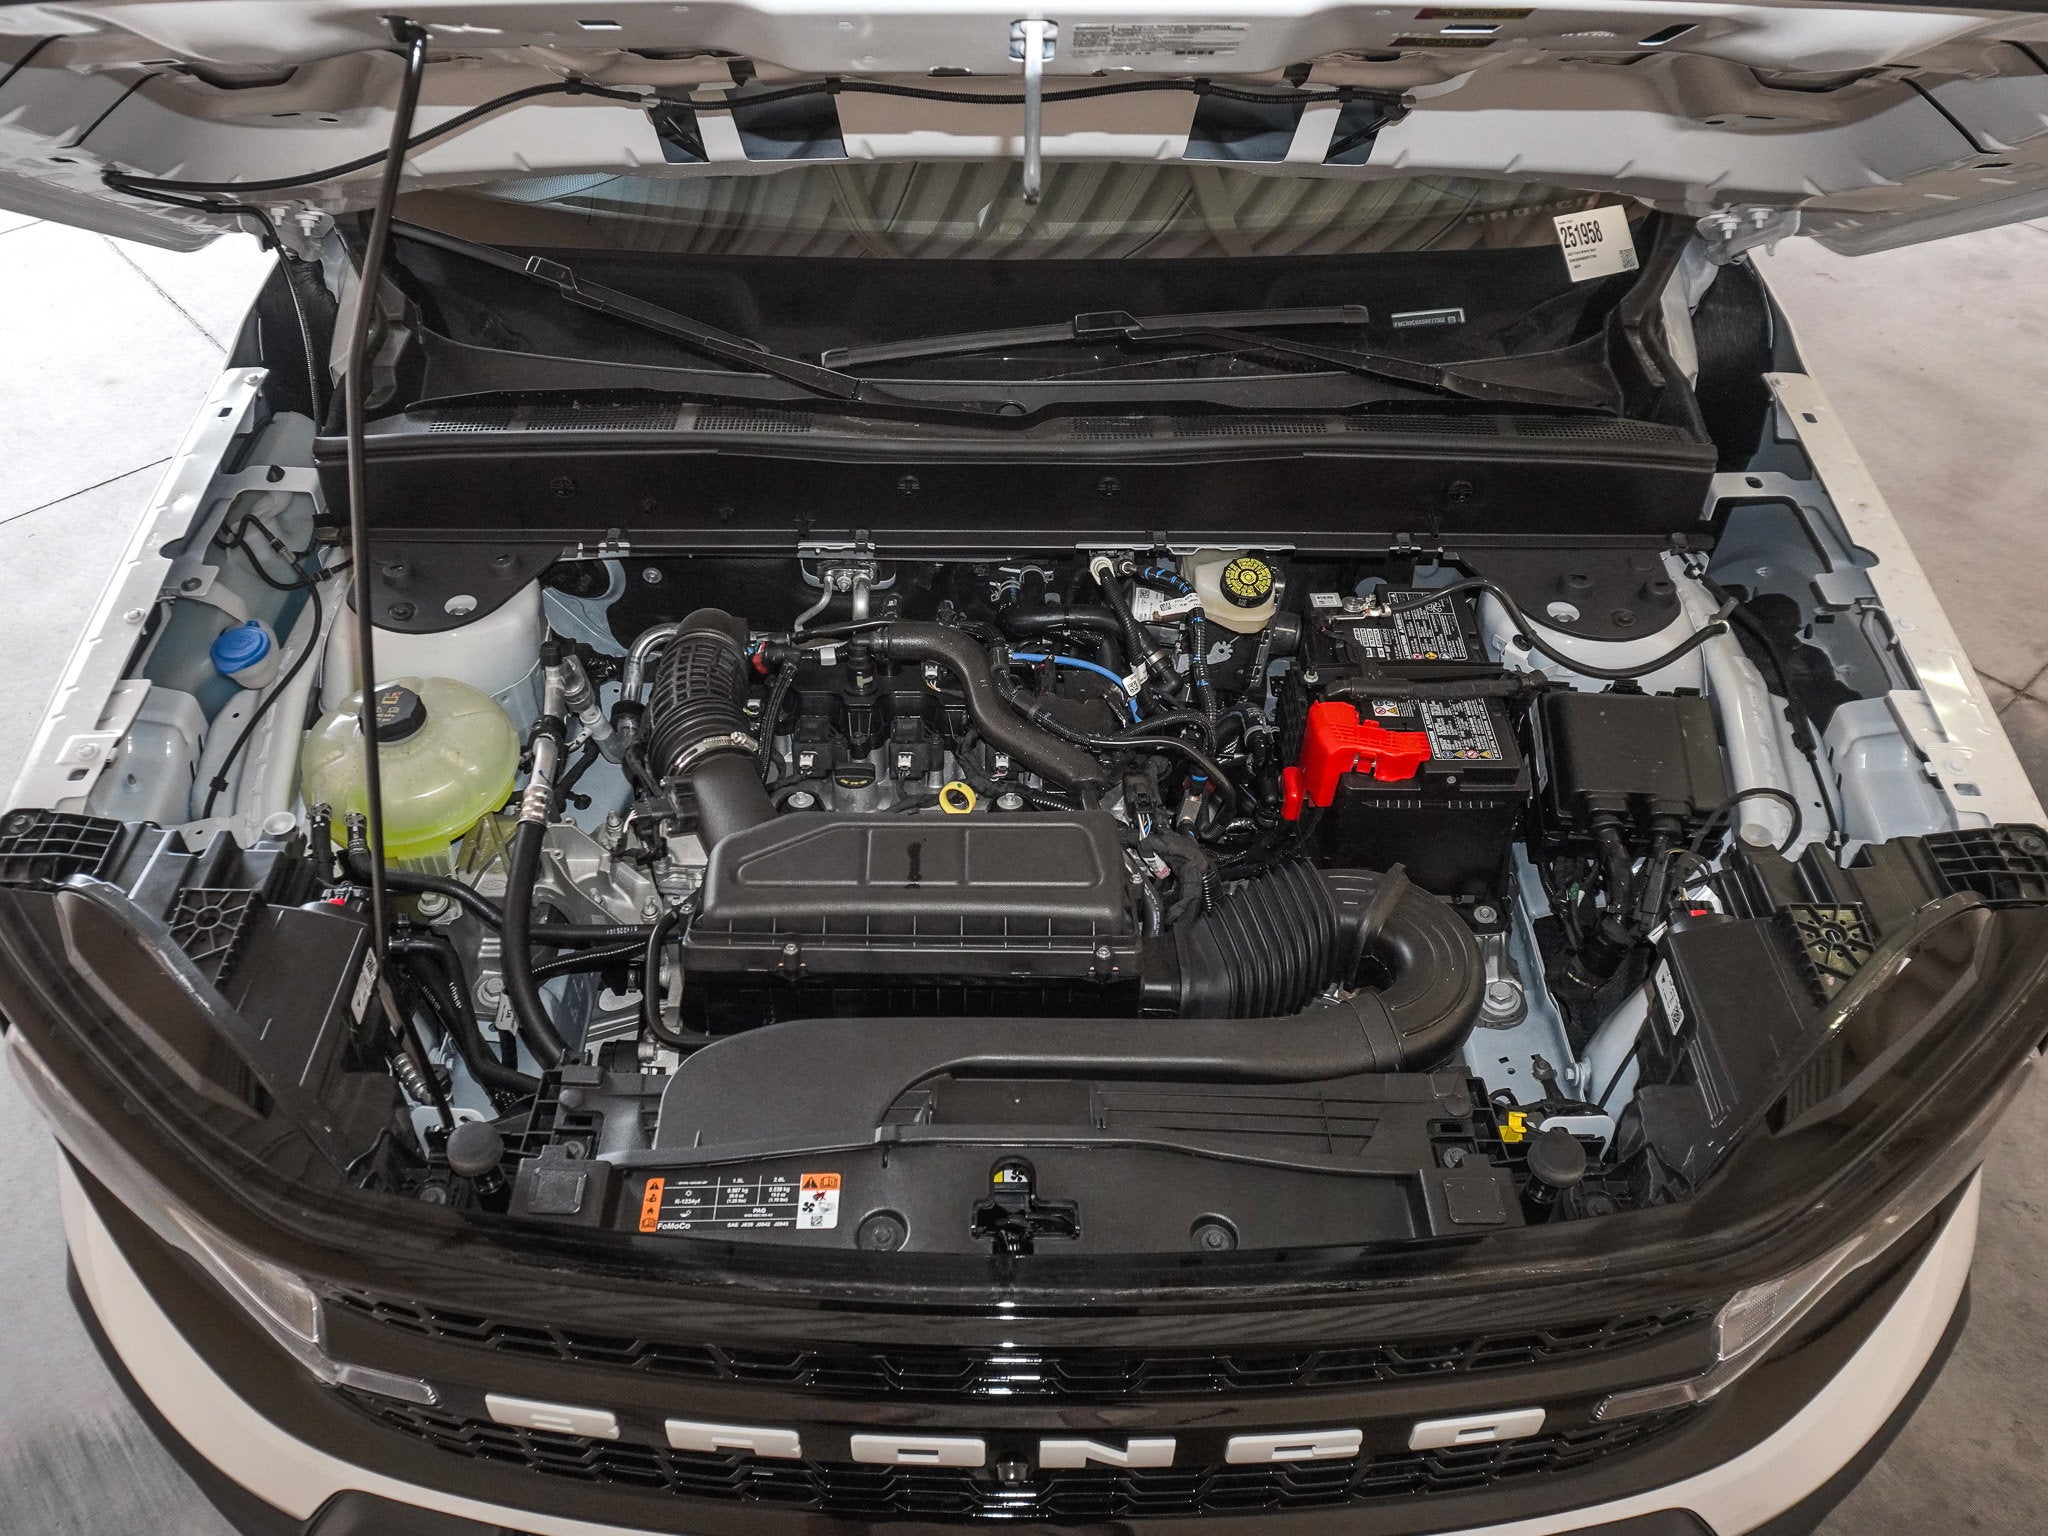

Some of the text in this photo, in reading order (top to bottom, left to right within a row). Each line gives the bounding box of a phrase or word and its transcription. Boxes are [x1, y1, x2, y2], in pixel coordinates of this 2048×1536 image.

[1560, 220, 1603, 249] 251958
[657, 1222, 692, 1230] FoMoCo
[485, 1393, 1547, 1468] BRONCO
